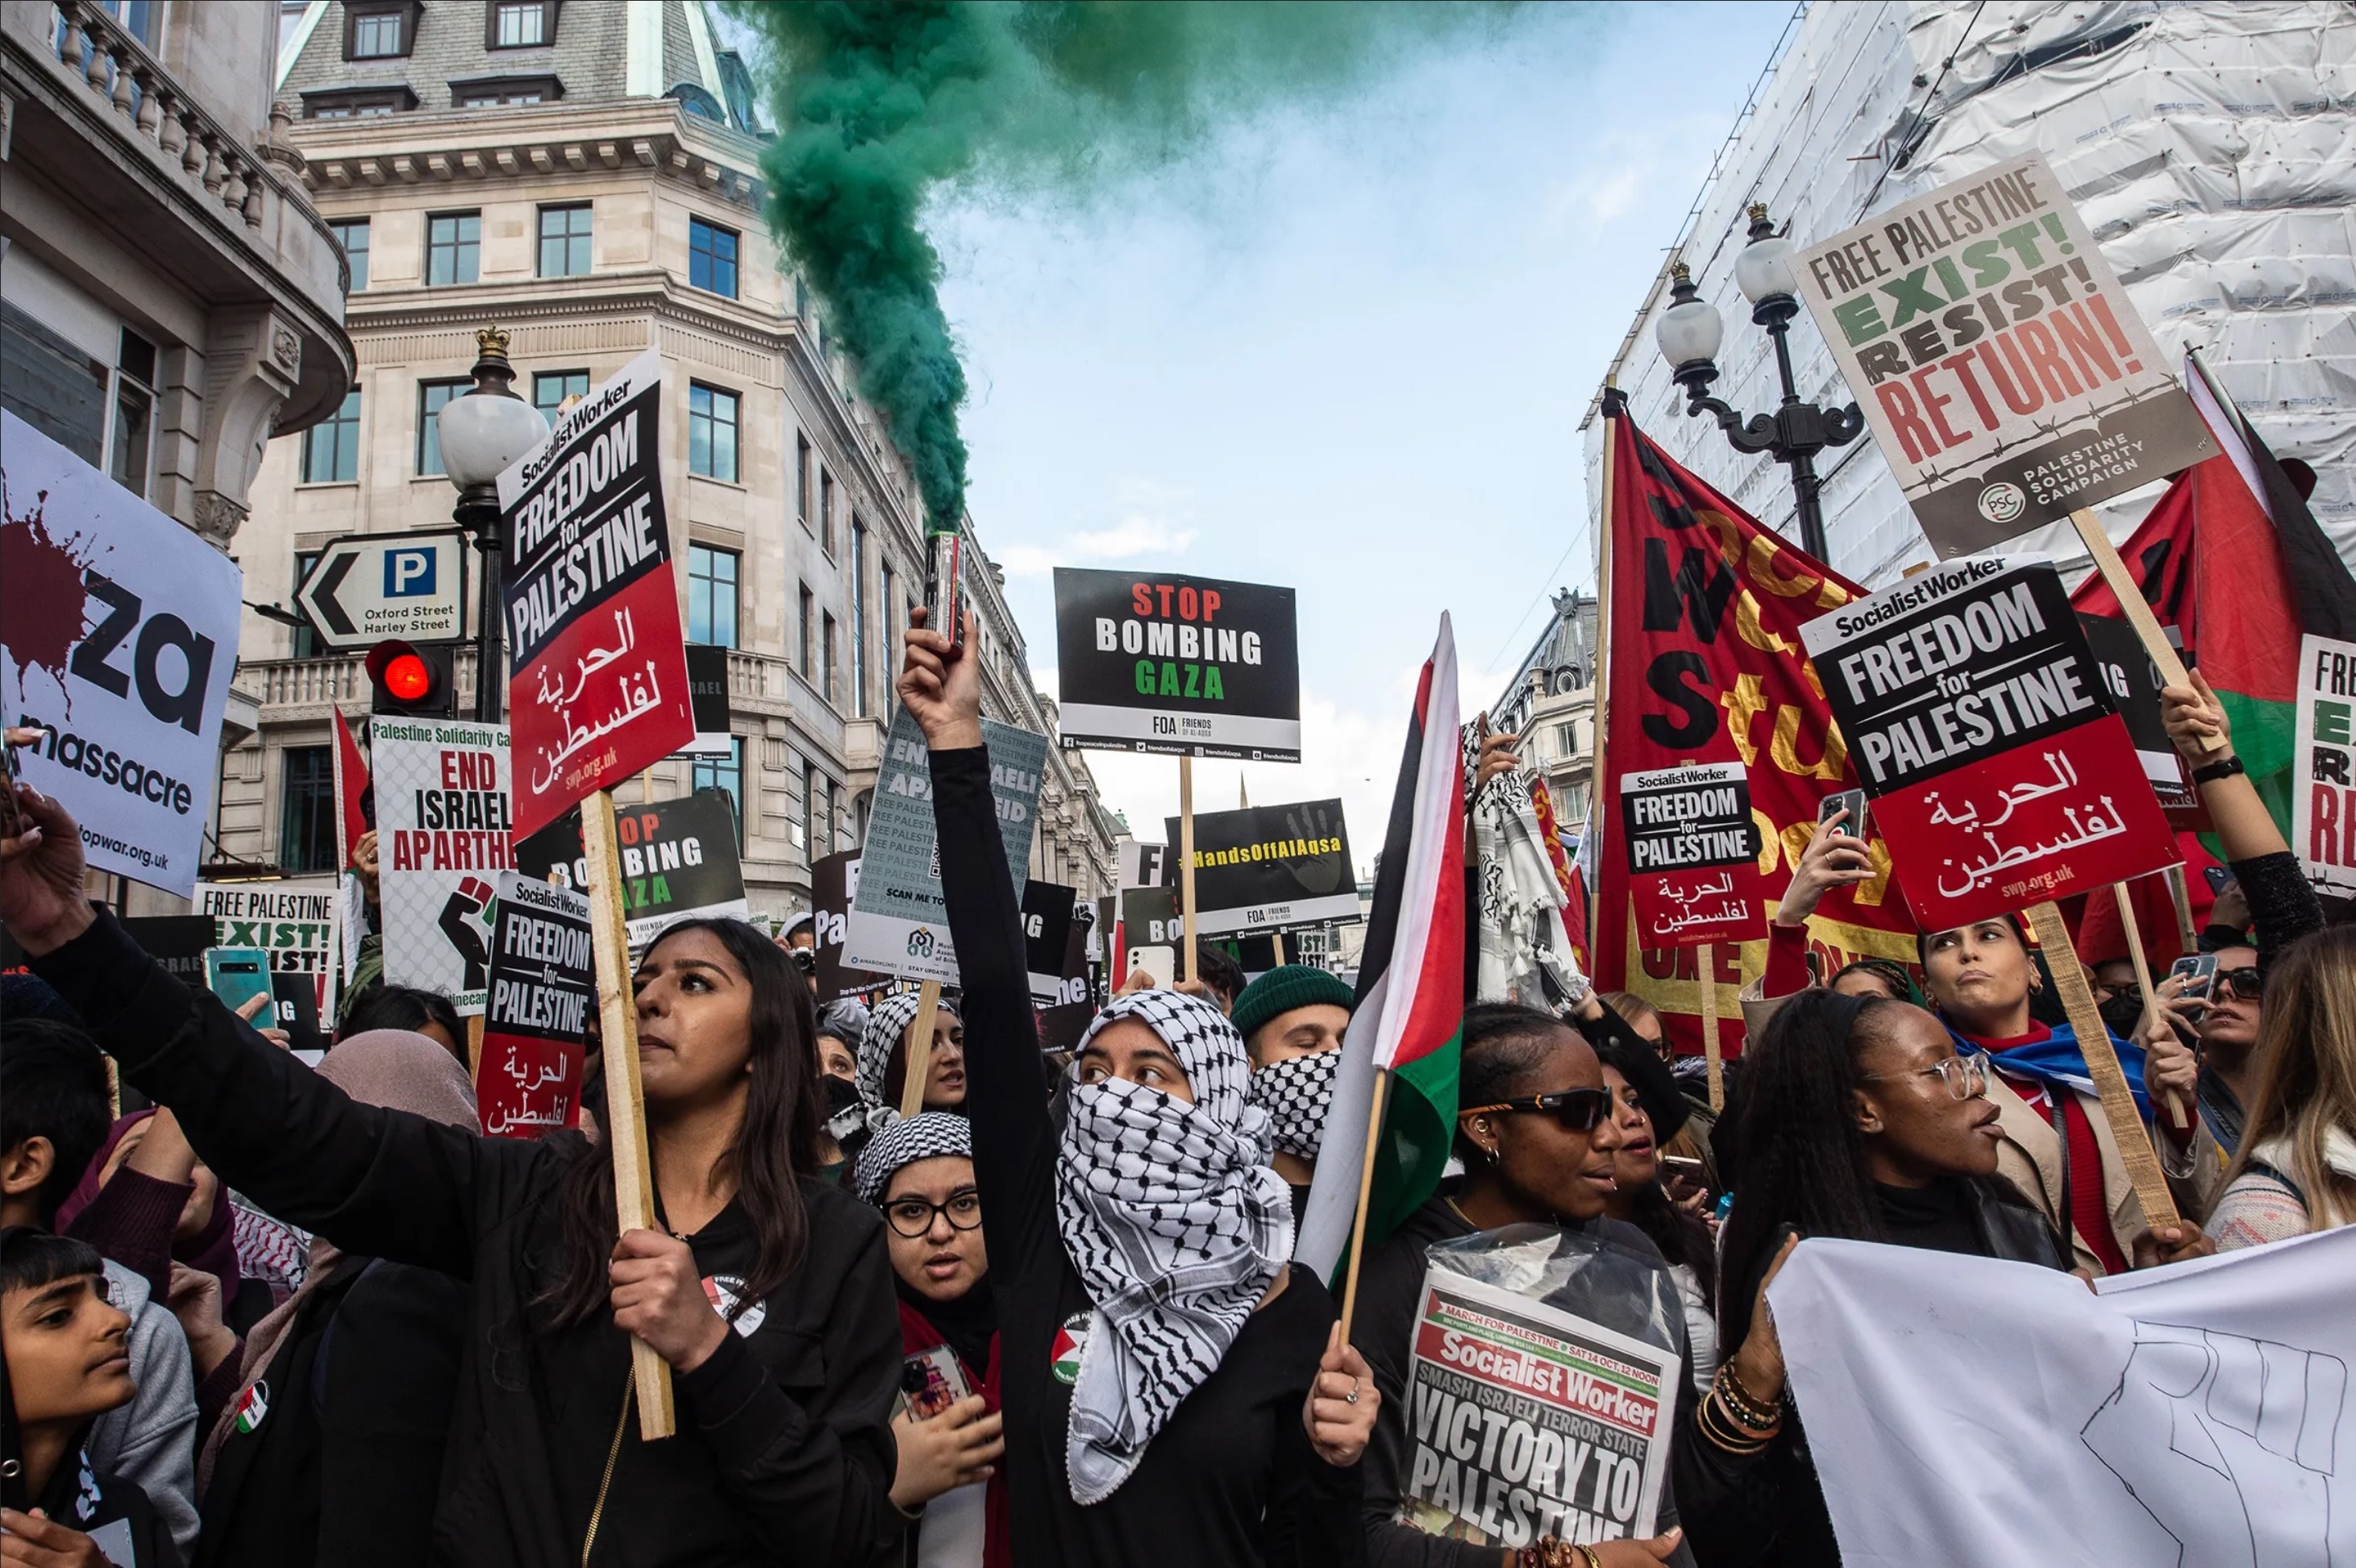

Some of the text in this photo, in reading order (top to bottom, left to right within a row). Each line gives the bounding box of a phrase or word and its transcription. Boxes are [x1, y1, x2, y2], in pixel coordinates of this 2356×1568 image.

[1809, 167, 2047, 300] FREE PALESTINE
[1832, 212, 2075, 348] EXIST!
[1855, 256, 2097, 385] RESIST!
[1875, 293, 2144, 465] RETURN!
[2024, 433, 2128, 482] PALESTINE
[2030, 441, 2144, 493] SOLIDARITY
[514, 410, 638, 564] FREEDOM
[2038, 458, 2138, 505] CAMPAIGN
[1988, 493, 2017, 513] PSC
[560, 519, 585, 555] for
[395, 552, 427, 593] P
[513, 492, 657, 658] PALESTINE
[365, 605, 454, 620] Oxford Street
[1131, 582, 1222, 622] STOP
[364, 619, 450, 634] Harley Street
[1095, 617, 1262, 666] BOMBING
[1838, 582, 2046, 705] FREEDOM
[537, 606, 635, 713] الحرية
[1135, 659, 1225, 700] GAZA
[2315, 650, 2356, 697] FRE
[1937, 670, 1971, 698] for
[373, 722, 432, 743] Palestine
[436, 727, 493, 748] Solidarity
[532, 659, 661, 795] لفلسطين
[1153, 716, 1212, 735] FOA FRIENDS
[1859, 655, 2096, 784] PALESTINE
[20, 713, 192, 815] massacre
[566, 747, 618, 790] swp.org.uk
[1030, 755, 1046, 766] FRE
[1031, 742, 1047, 755] FRE
[440, 750, 497, 791] END
[416, 789, 513, 830] ISRAEL
[897, 801, 934, 818] PALEST
[1634, 788, 1738, 825] FREEDOM
[1924, 750, 2078, 834] الحرية
[1680, 821, 1697, 834] for
[2309, 783, 2356, 869] RE
[551, 837, 704, 888] BOBING
[1634, 830, 1750, 867] PALESTINE
[1938, 795, 2128, 899] لفلسطين
[886, 888, 946, 905] SCAN ME TO
[1658, 872, 1734, 904] الحرية
[2001, 865, 2075, 900] swp.org.uk
[204, 890, 331, 920] FREE PALESTINE
[1247, 909, 1266, 924] FOA
[1268, 906, 1291, 916] FRIENDS
[1654, 899, 1749, 934] لفلسطين
[271, 950, 328, 972] IST!
[505, 913, 590, 971] FREEDOM
[937, 942, 954, 950] Musli
[1297, 935, 1326, 952] IST!
[543, 963, 557, 985] for
[908, 965, 923, 973] STAY
[924, 967, 950, 977] UPDATED
[492, 978, 589, 1034] PALESTINE
[503, 1045, 568, 1091] الحرية
[488, 1091, 568, 1133] لفلسطين
[714, 1275, 735, 1284] FREE
[1446, 1305, 1659, 1387] MARCH FOR PALESTINE SAT 14 OCT, 12 NOON
[1441, 1330, 1563, 1401] Socialist
[1565, 1370, 1657, 1430] Worker
[1418, 1362, 1475, 1400] SMASH
[1476, 1384, 1540, 1424] ISRAELI
[1541, 1404, 1601, 1443] TERROR
[1603, 1425, 1646, 1462] STATE
[1416, 1380, 1641, 1523] VICTORY TO
